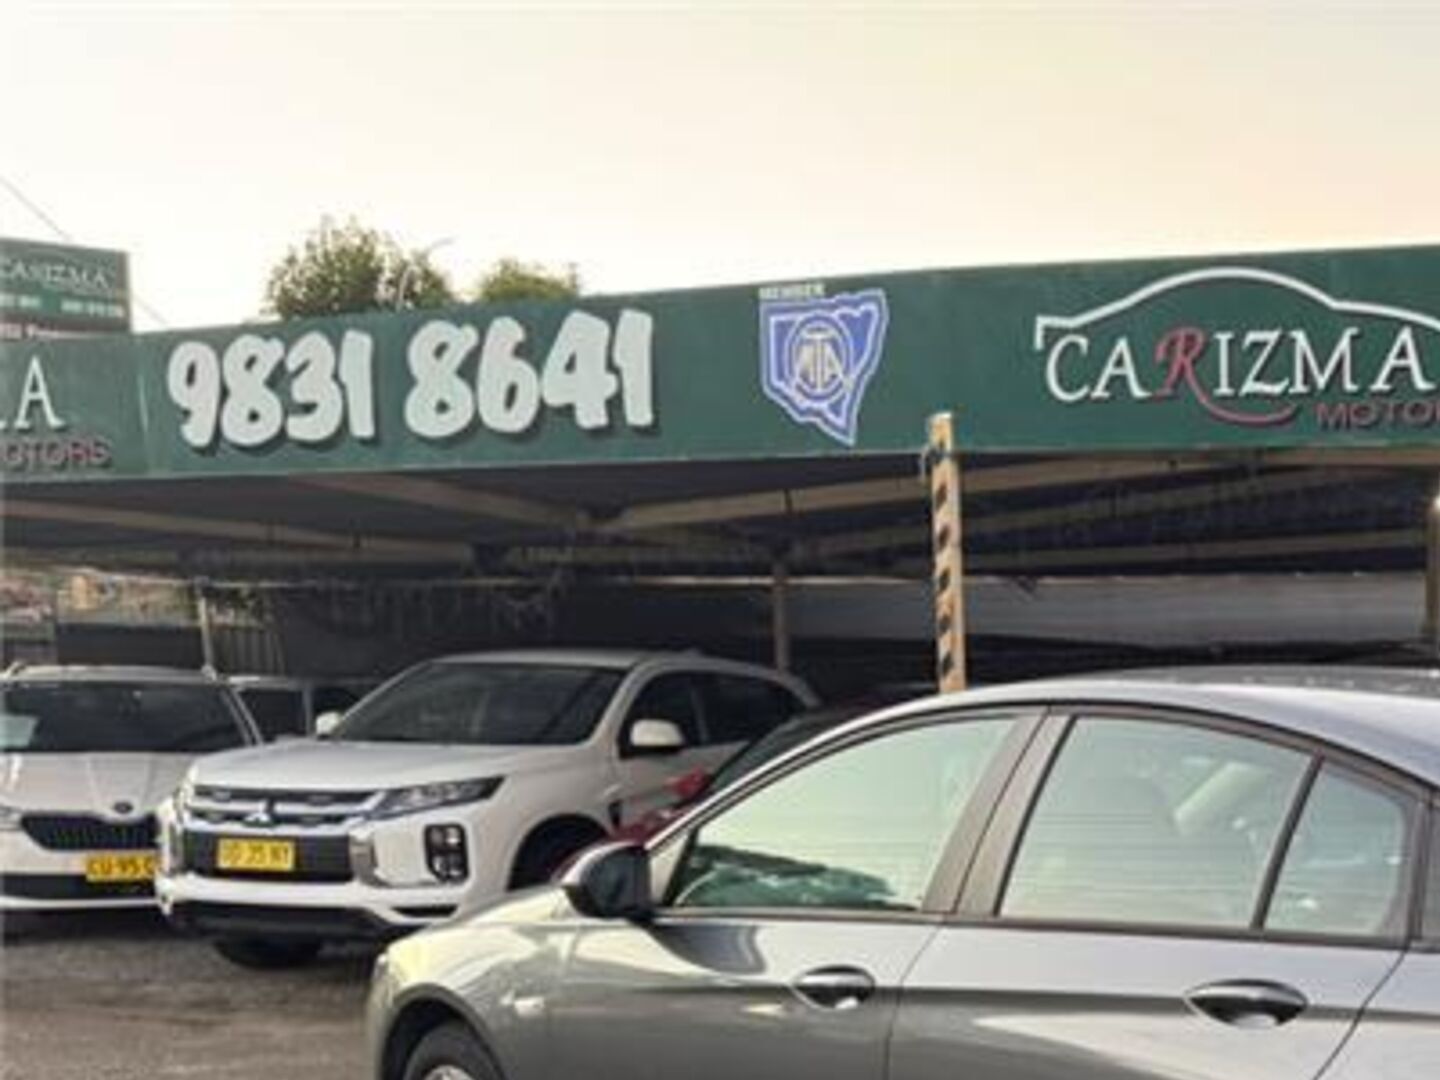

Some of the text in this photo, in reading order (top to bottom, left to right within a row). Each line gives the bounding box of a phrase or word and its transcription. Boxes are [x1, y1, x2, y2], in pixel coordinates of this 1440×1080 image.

[0, 355, 66, 430] A
[167, 309, 654, 447] 9831 8641
[1046, 326, 1436, 420] CARIZMA
